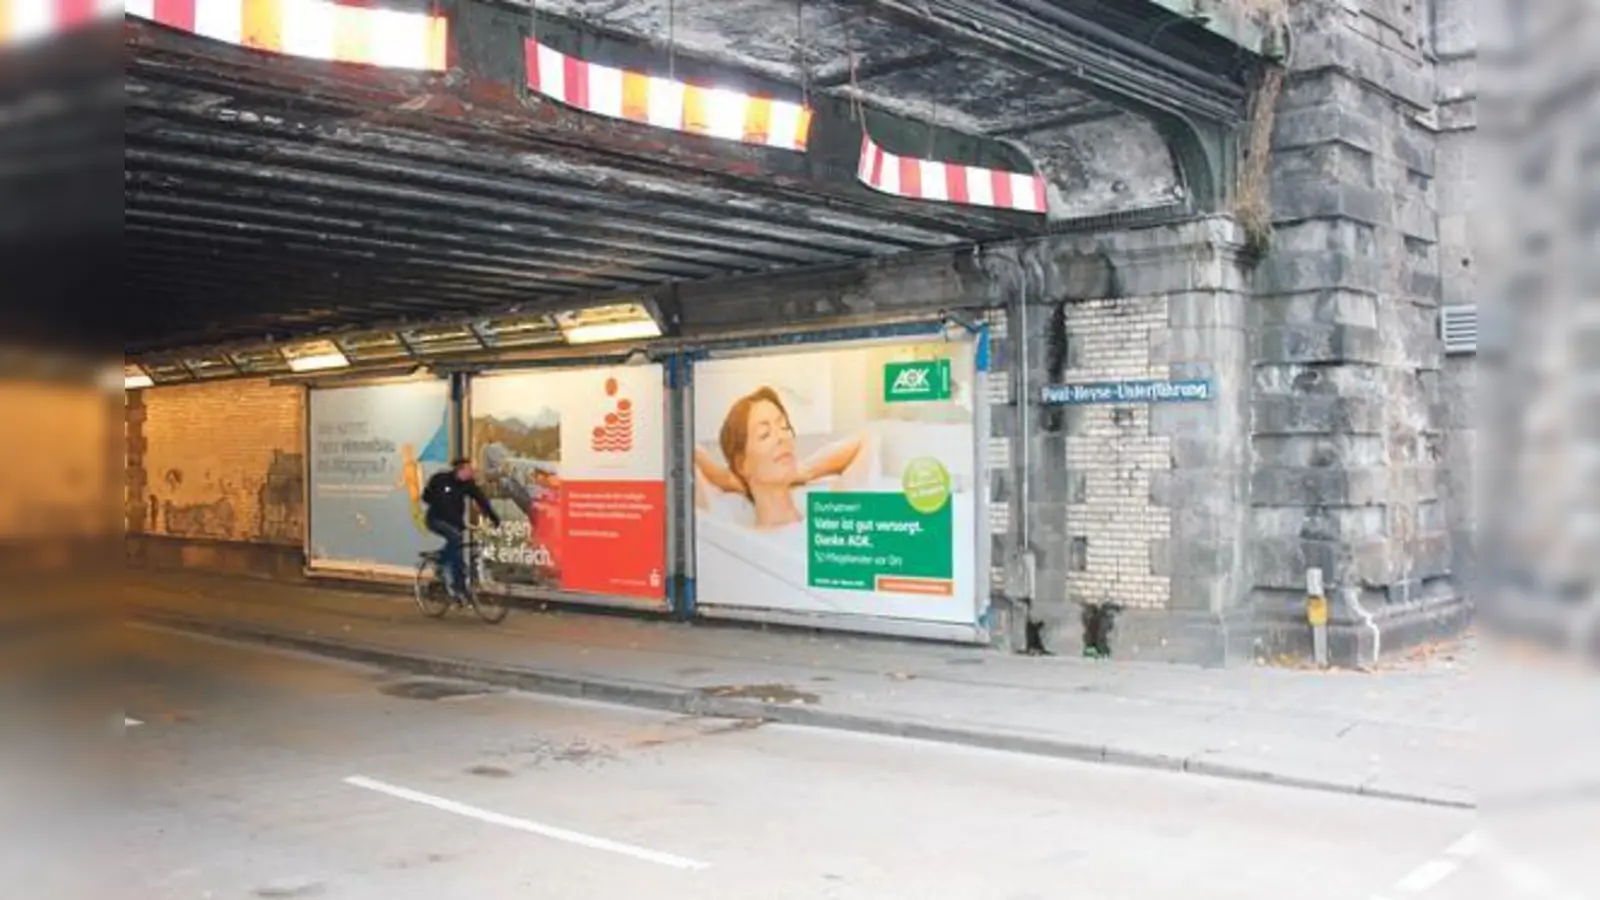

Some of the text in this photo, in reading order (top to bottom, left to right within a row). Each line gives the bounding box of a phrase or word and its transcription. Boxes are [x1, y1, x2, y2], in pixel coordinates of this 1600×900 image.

[892, 368, 930, 388] AOK
[1041, 382, 1207, 402] Paul-Heyse-Unterführung
[814, 517, 925, 535] Vater ist gut versorgt.
[814, 534, 845, 546] Danke
[498, 541, 556, 567] einfach.
